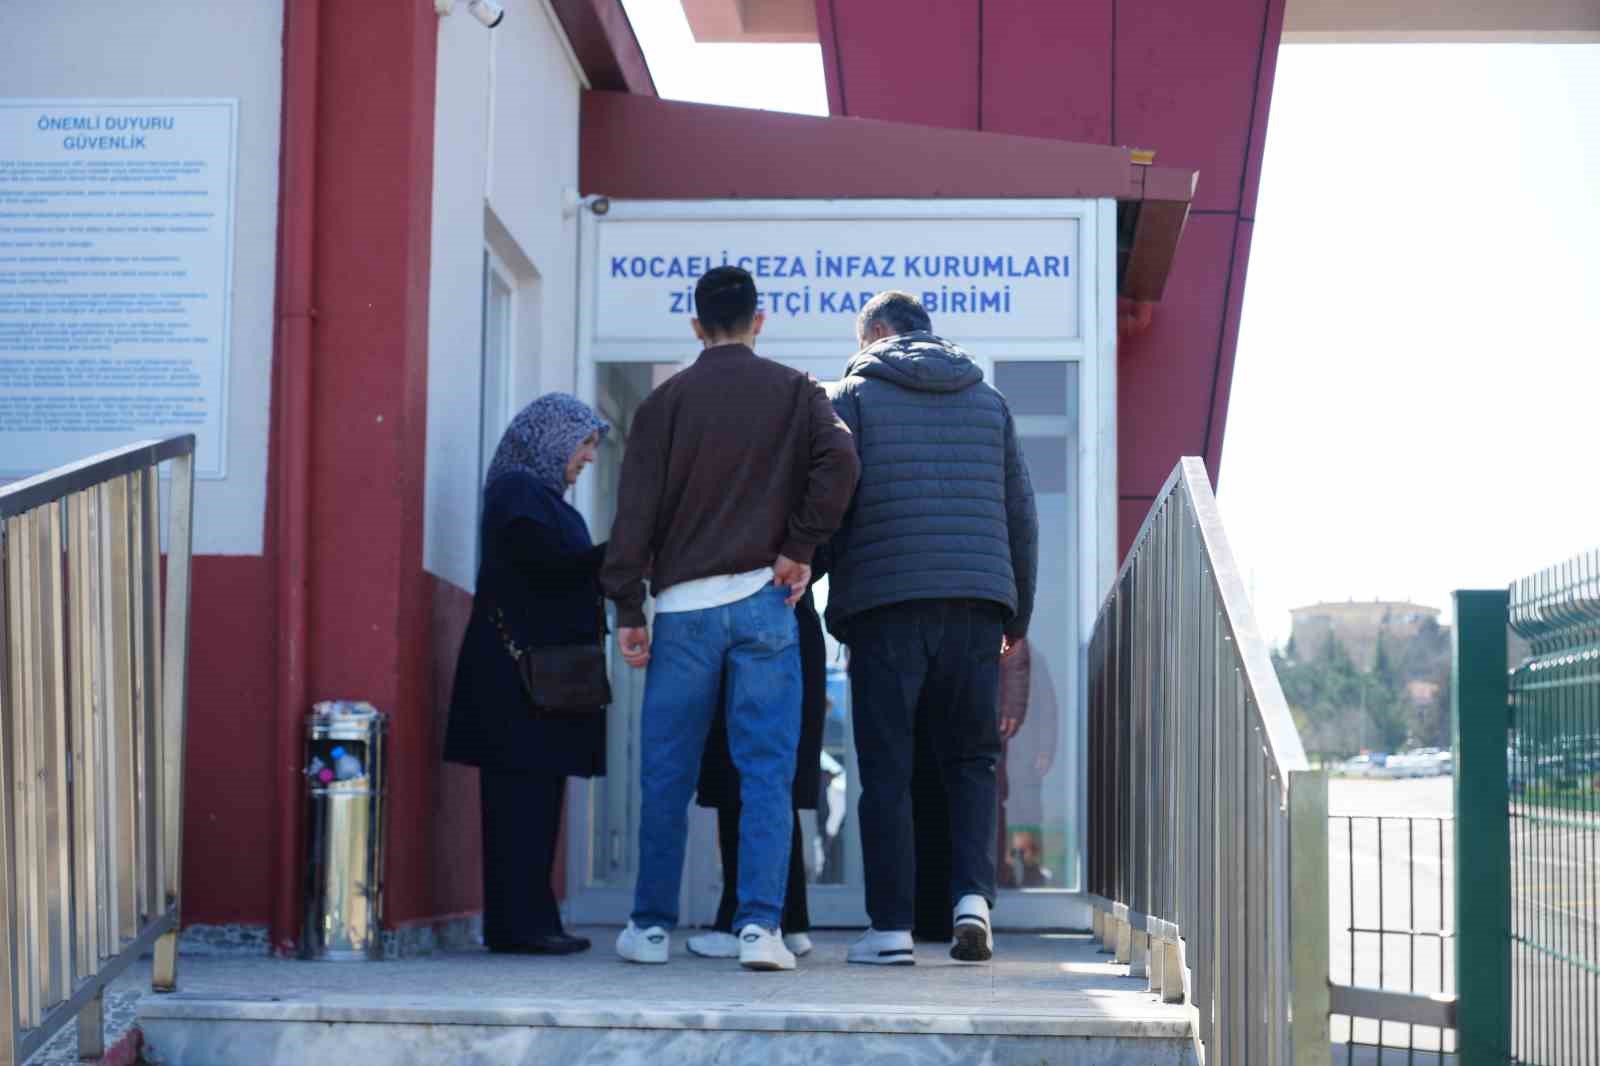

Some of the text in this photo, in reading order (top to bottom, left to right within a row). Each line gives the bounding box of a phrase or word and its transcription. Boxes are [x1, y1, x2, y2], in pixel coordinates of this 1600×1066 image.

[105, 115, 174, 130] DUYURU
[63, 134, 145, 150] GÜVENLİK
[815, 250, 896, 278] İNFAZ
[904, 255, 1070, 278] KURUMLARI
[921, 286, 1011, 313] BİRİMİ
